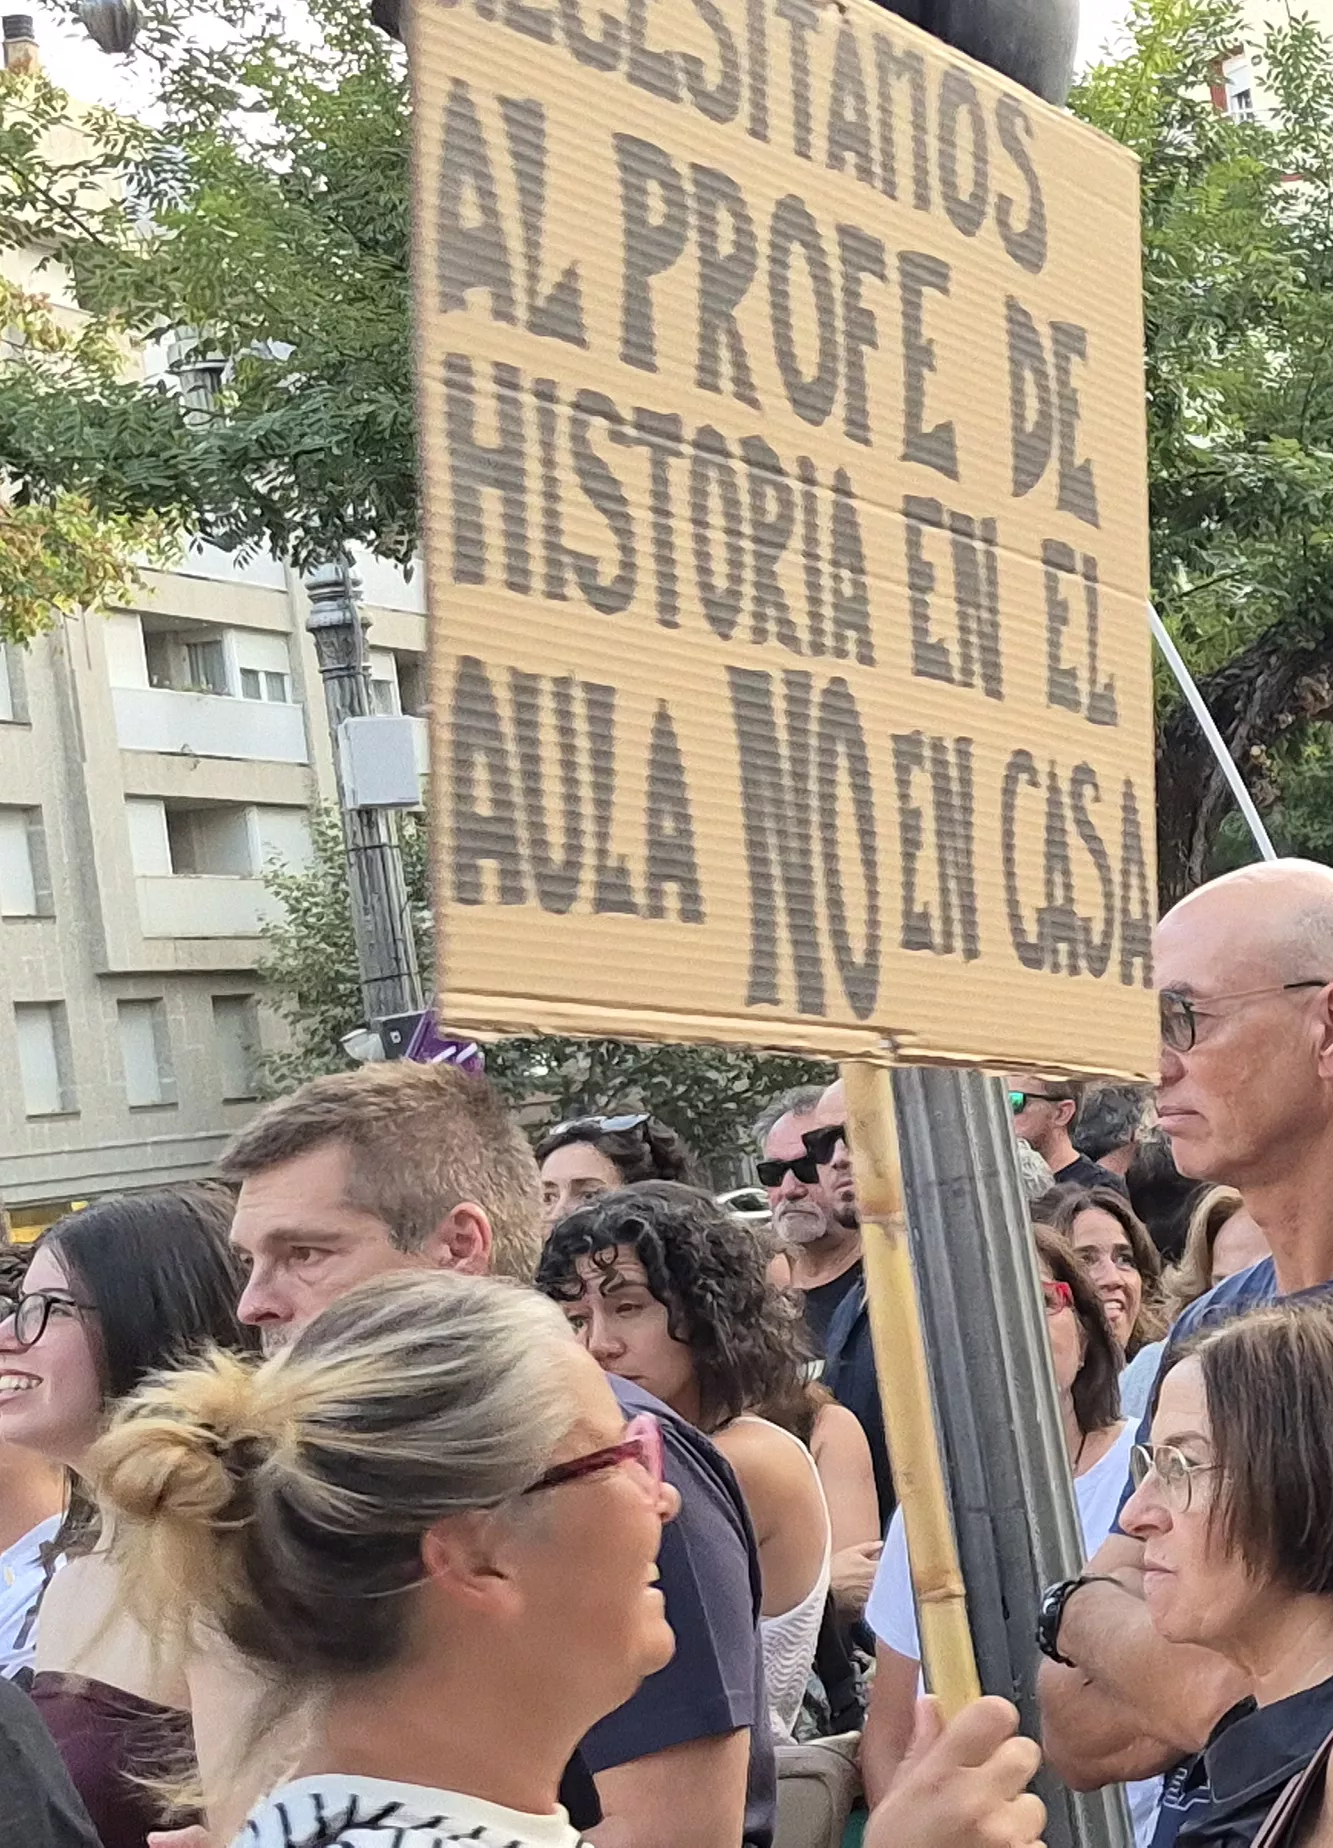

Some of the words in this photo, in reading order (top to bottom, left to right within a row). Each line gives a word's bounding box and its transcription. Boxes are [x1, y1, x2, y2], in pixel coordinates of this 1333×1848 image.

[438, 76, 589, 348] AL
[612, 131, 962, 479] PROFE
[1005, 294, 1101, 528] DE
[441, 350, 876, 667] HISTORIA
[902, 493, 1004, 702] EN
[1041, 537, 1119, 727] EL
[449, 655, 705, 925] AULA
[726, 665, 883, 1021] NO
[891, 730, 981, 961] EN
[1002, 747, 1154, 989] CASA
